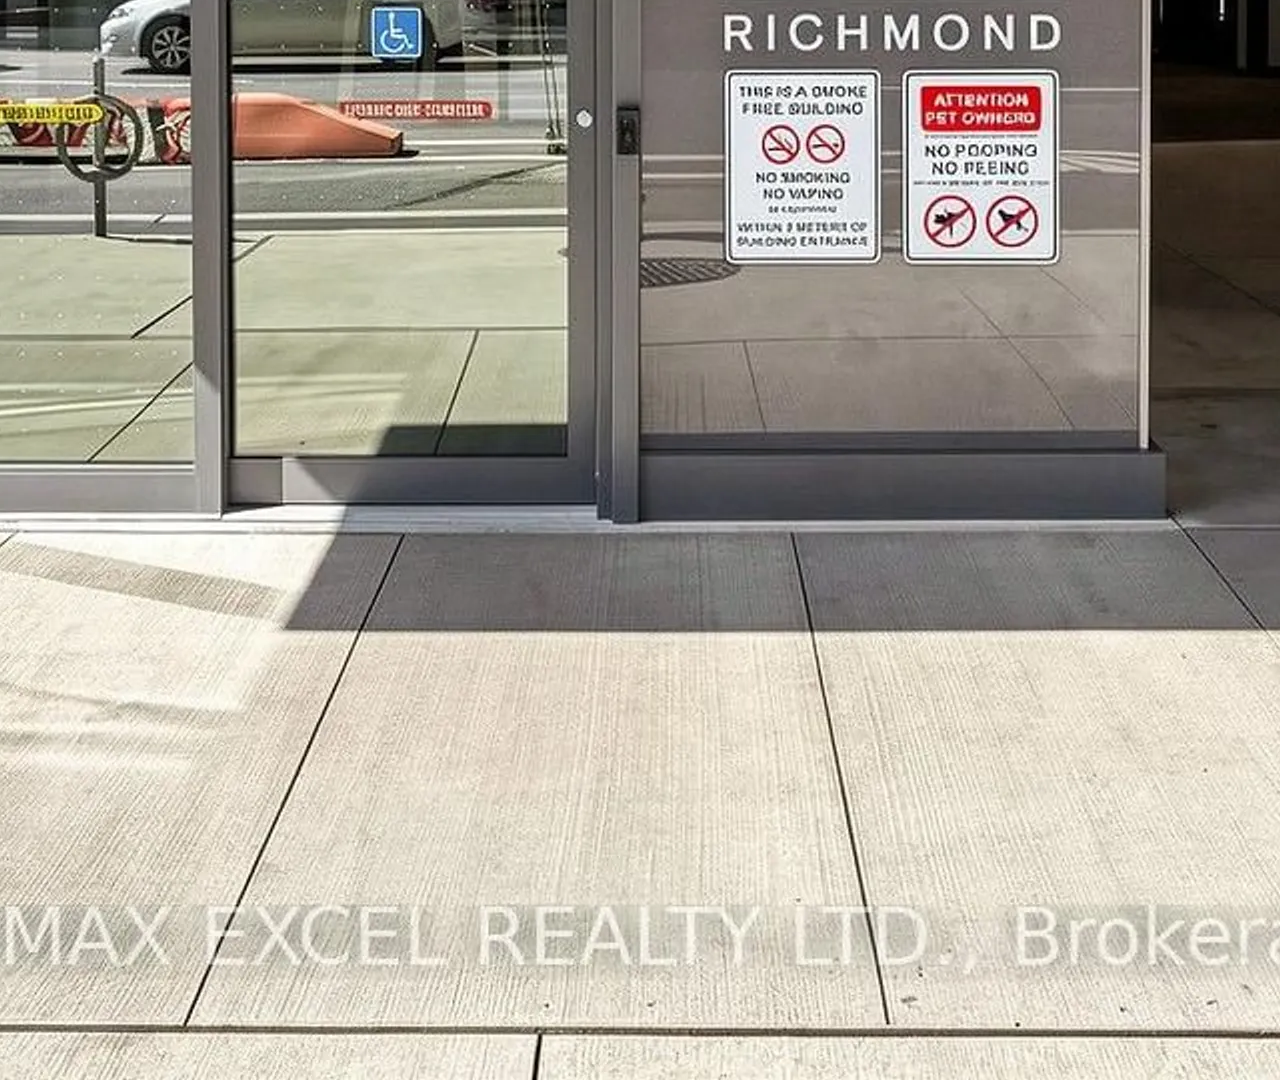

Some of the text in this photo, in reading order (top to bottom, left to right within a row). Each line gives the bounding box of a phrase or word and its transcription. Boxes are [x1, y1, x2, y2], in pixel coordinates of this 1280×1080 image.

[723, 13, 1062, 52] RICHMOND
[776, 85, 793, 98] IS
[794, 85, 808, 98] A
[812, 85, 868, 98] SMOKE
[933, 92, 1030, 108] ATTENTION
[741, 102, 784, 115] FREE
[924, 111, 958, 125] PET
[924, 143, 1038, 158] NO POOPING
[931, 161, 1030, 176] NO PEEING
[755, 172, 852, 184] NO SMOKING
[763, 187, 845, 200] NO VAPING
